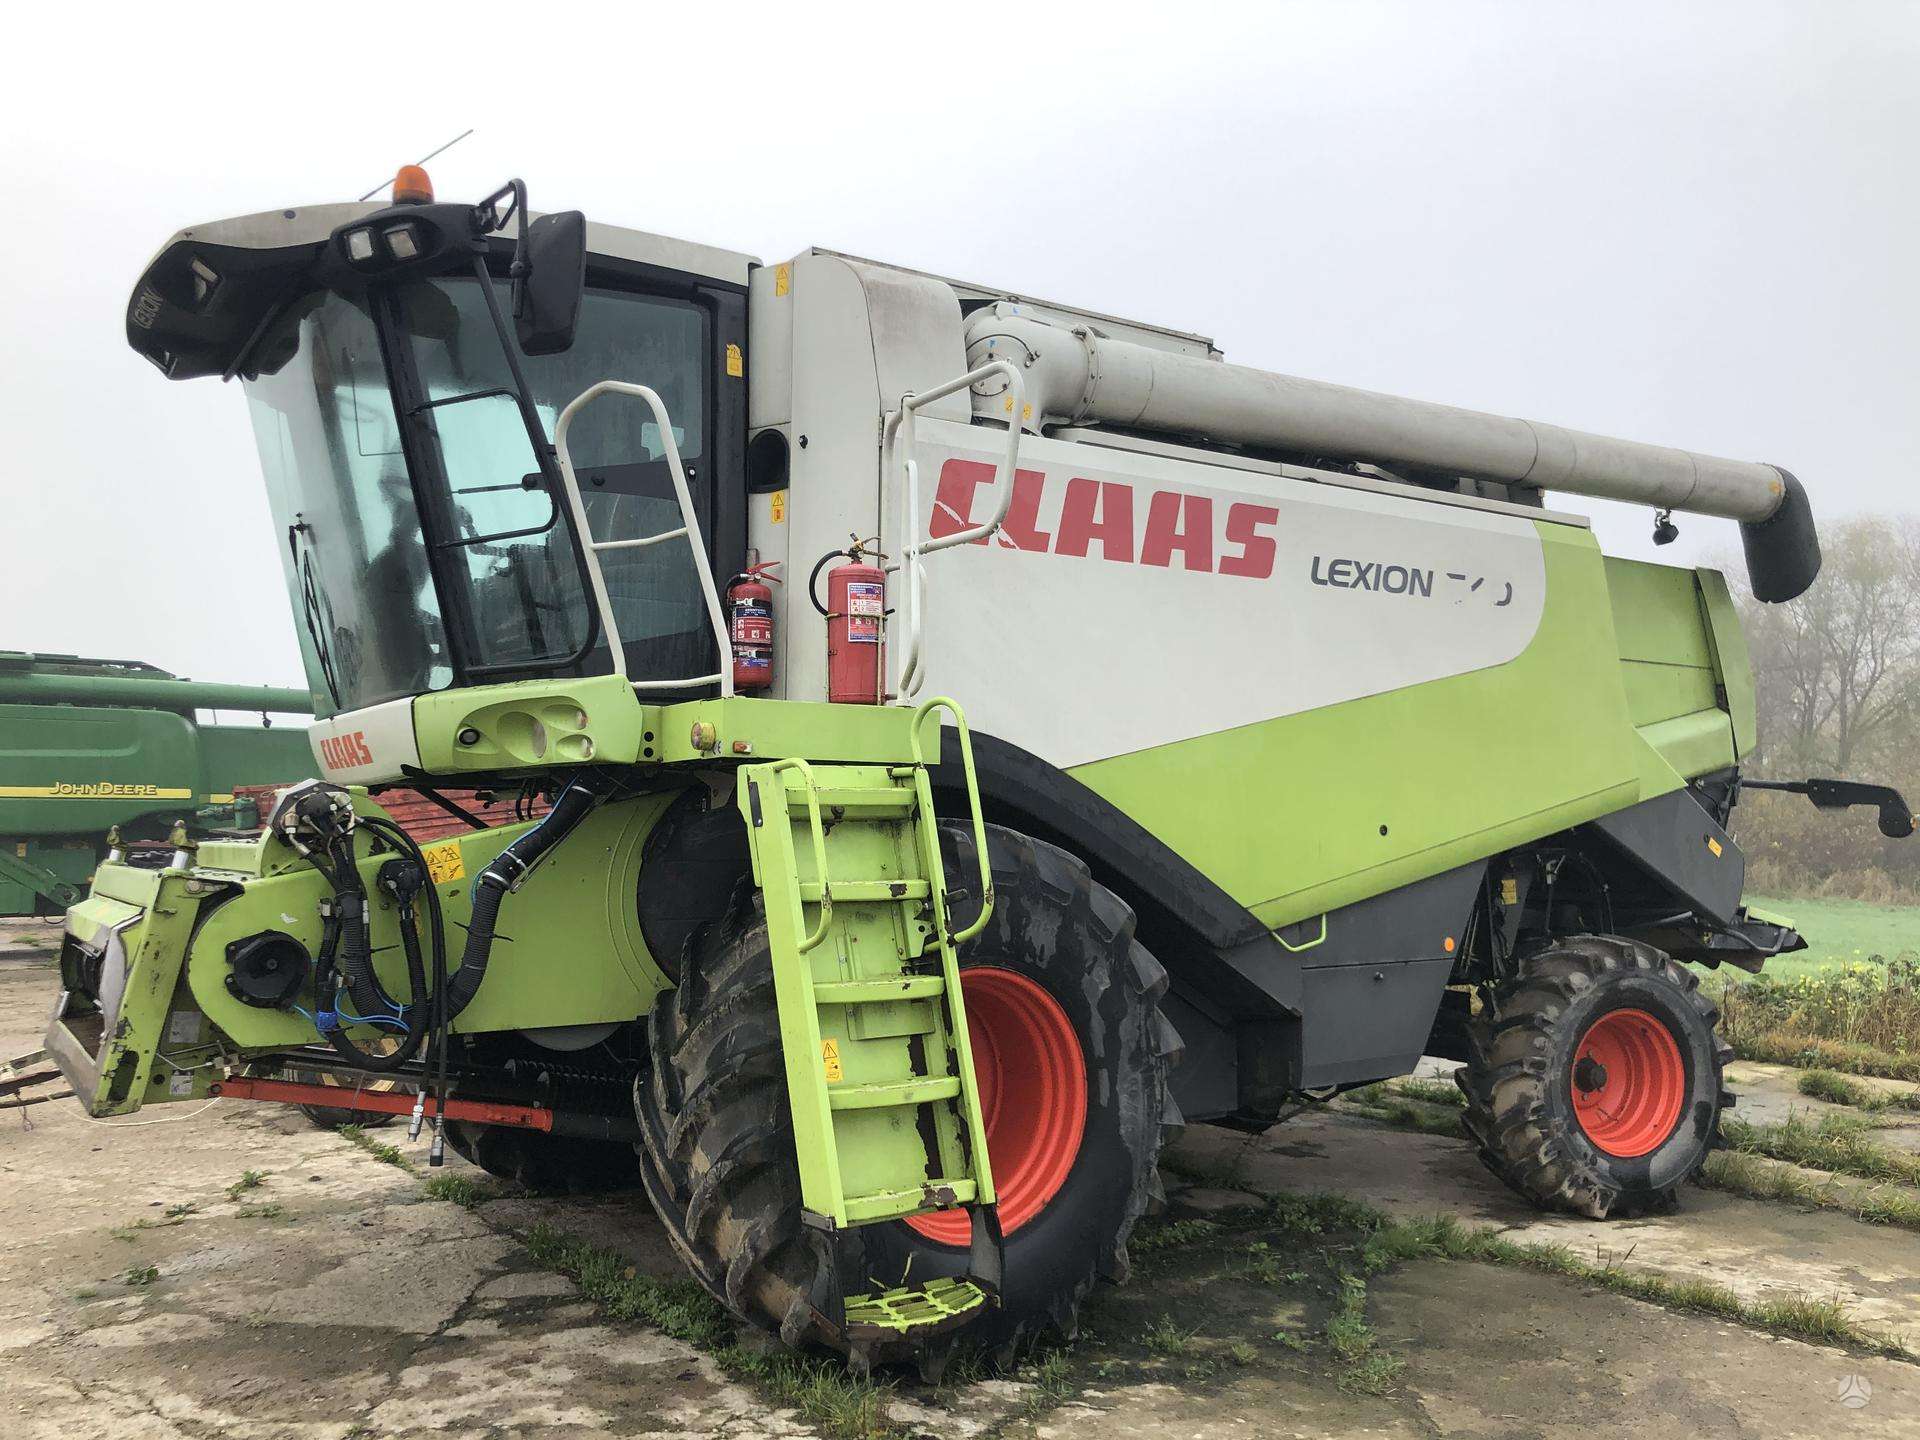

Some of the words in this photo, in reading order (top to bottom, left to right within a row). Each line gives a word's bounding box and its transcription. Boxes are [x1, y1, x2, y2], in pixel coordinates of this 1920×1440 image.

[929, 458, 1280, 580] CLAAS
[1310, 556, 1434, 598] LEXION
[319, 731, 374, 770] CLAAS
[50, 781, 97, 796] JOHN
[99, 781, 158, 796] DEERE
